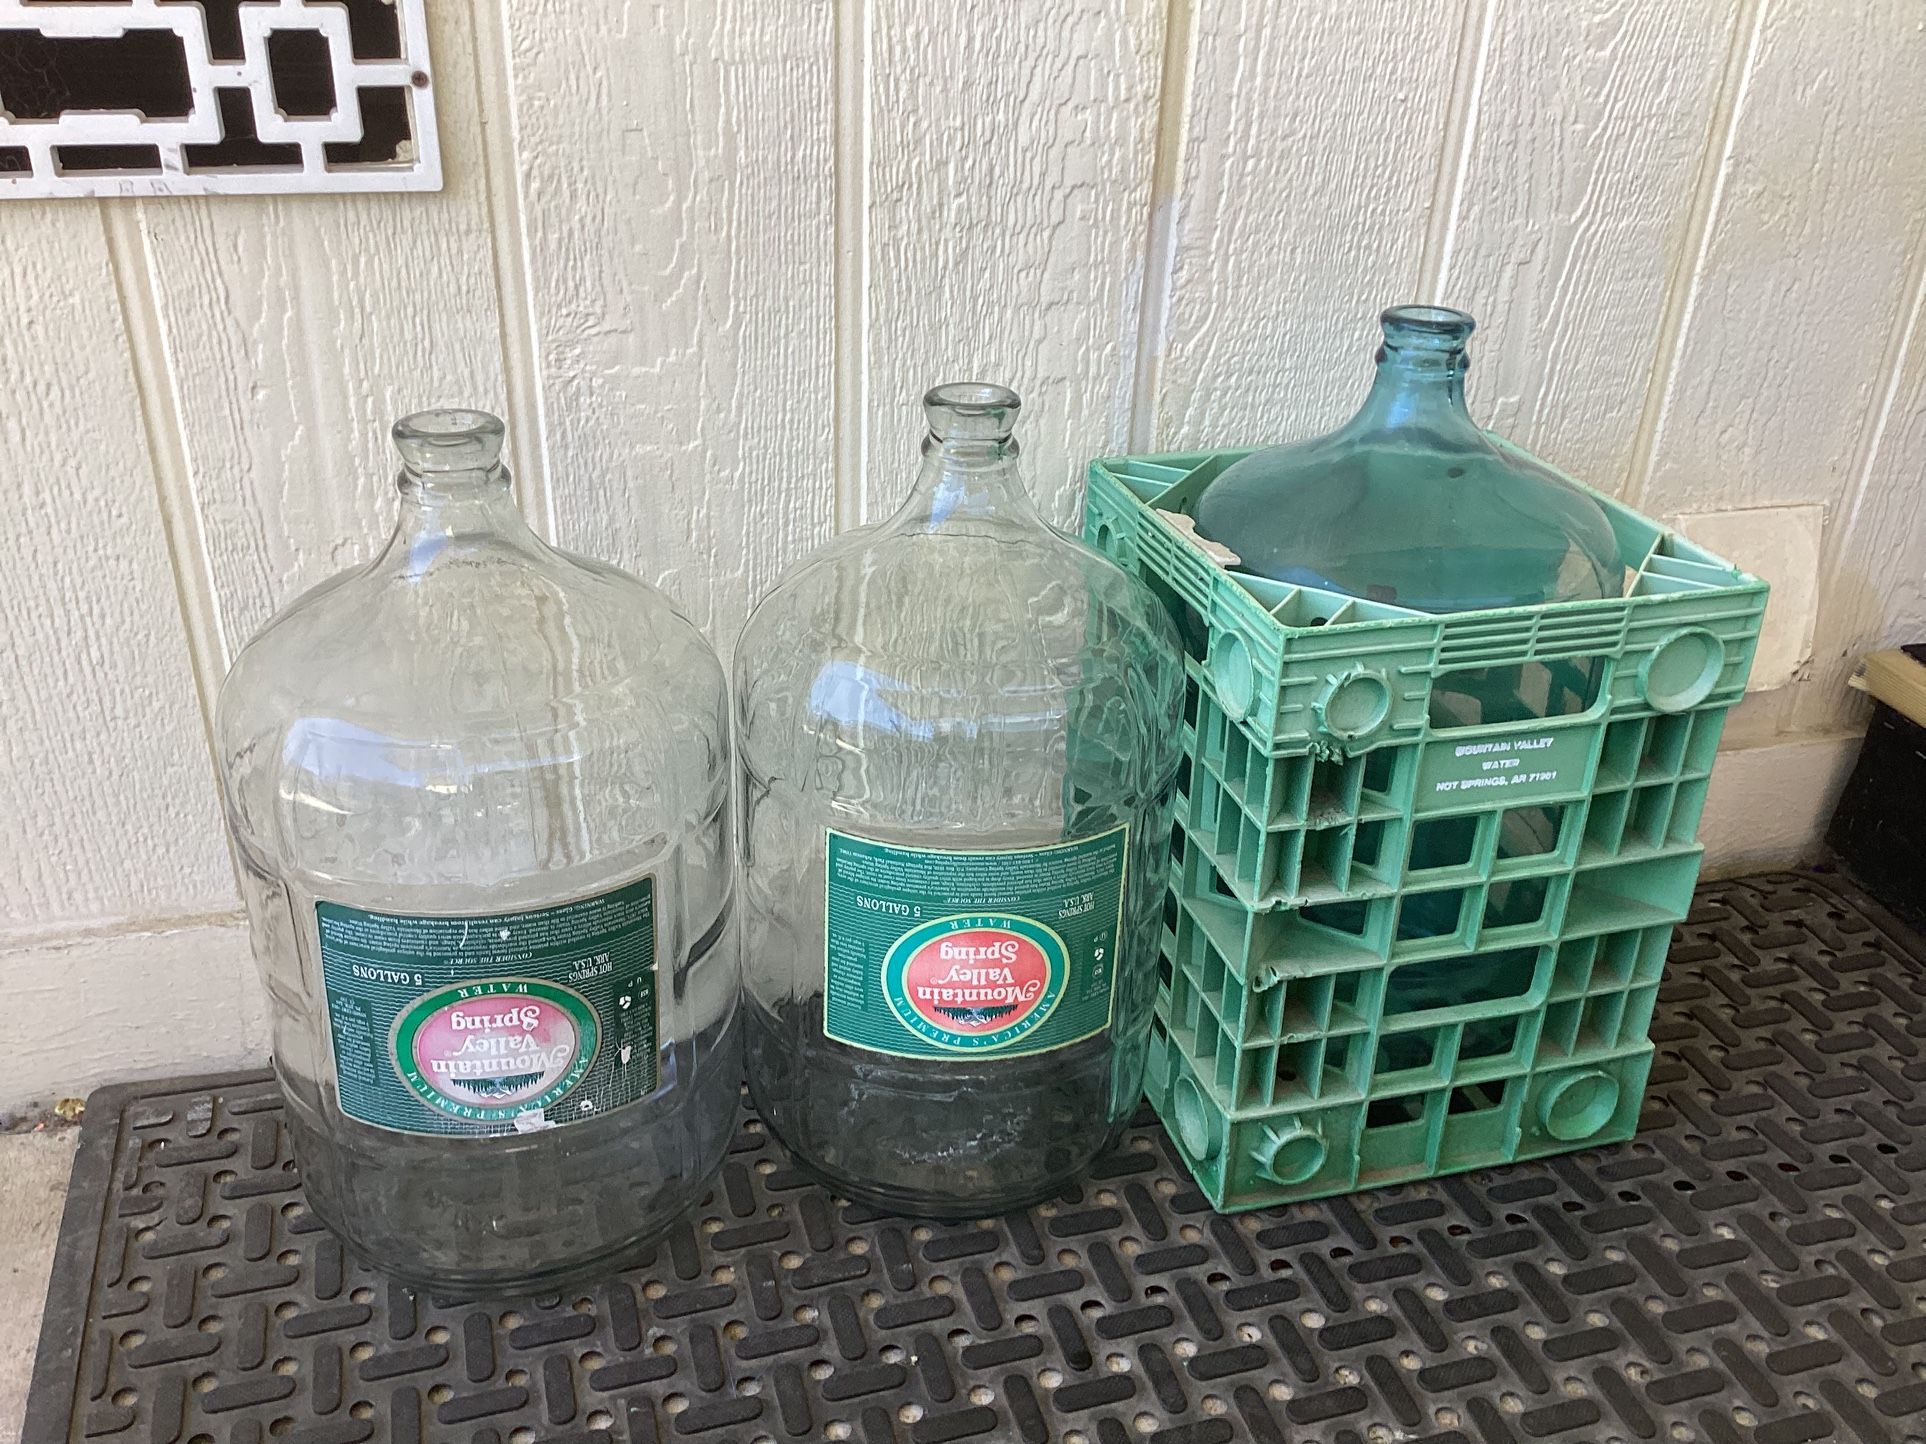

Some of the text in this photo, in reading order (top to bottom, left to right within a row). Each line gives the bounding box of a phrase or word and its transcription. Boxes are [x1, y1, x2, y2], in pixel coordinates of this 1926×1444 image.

[1455, 737, 1554, 757] MOUNTAIN VALLEY
[1482, 758, 1520, 770] WATER
[1436, 781, 1459, 791] HOT
[1511, 773, 1527, 784] AR
[856, 896, 921, 917] 5 GALLONS
[987, 896, 1020, 904] CONSIDER
[1058, 900, 1094, 919] HOT SPRINGS
[949, 918, 1011, 930] WATER
[480, 956, 493, 964] THE
[496, 952, 532, 962] CONSIDER
[940, 940, 1019, 964] Spring
[352, 964, 422, 986] 5 GALLONS
[568, 962, 612, 982] HOT SPRINGS
[938, 966, 1014, 985] Valley
[457, 983, 528, 998] WATER
[917, 980, 1040, 1004] Mountain
[450, 1006, 540, 1033] Spring
[894, 991, 1055, 1046] AMERICA'S PREMIUM
[453, 1034, 540, 1058] Valley
[430, 1044, 570, 1078] Mountain
[407, 1070, 485, 1120] PREMIUM
